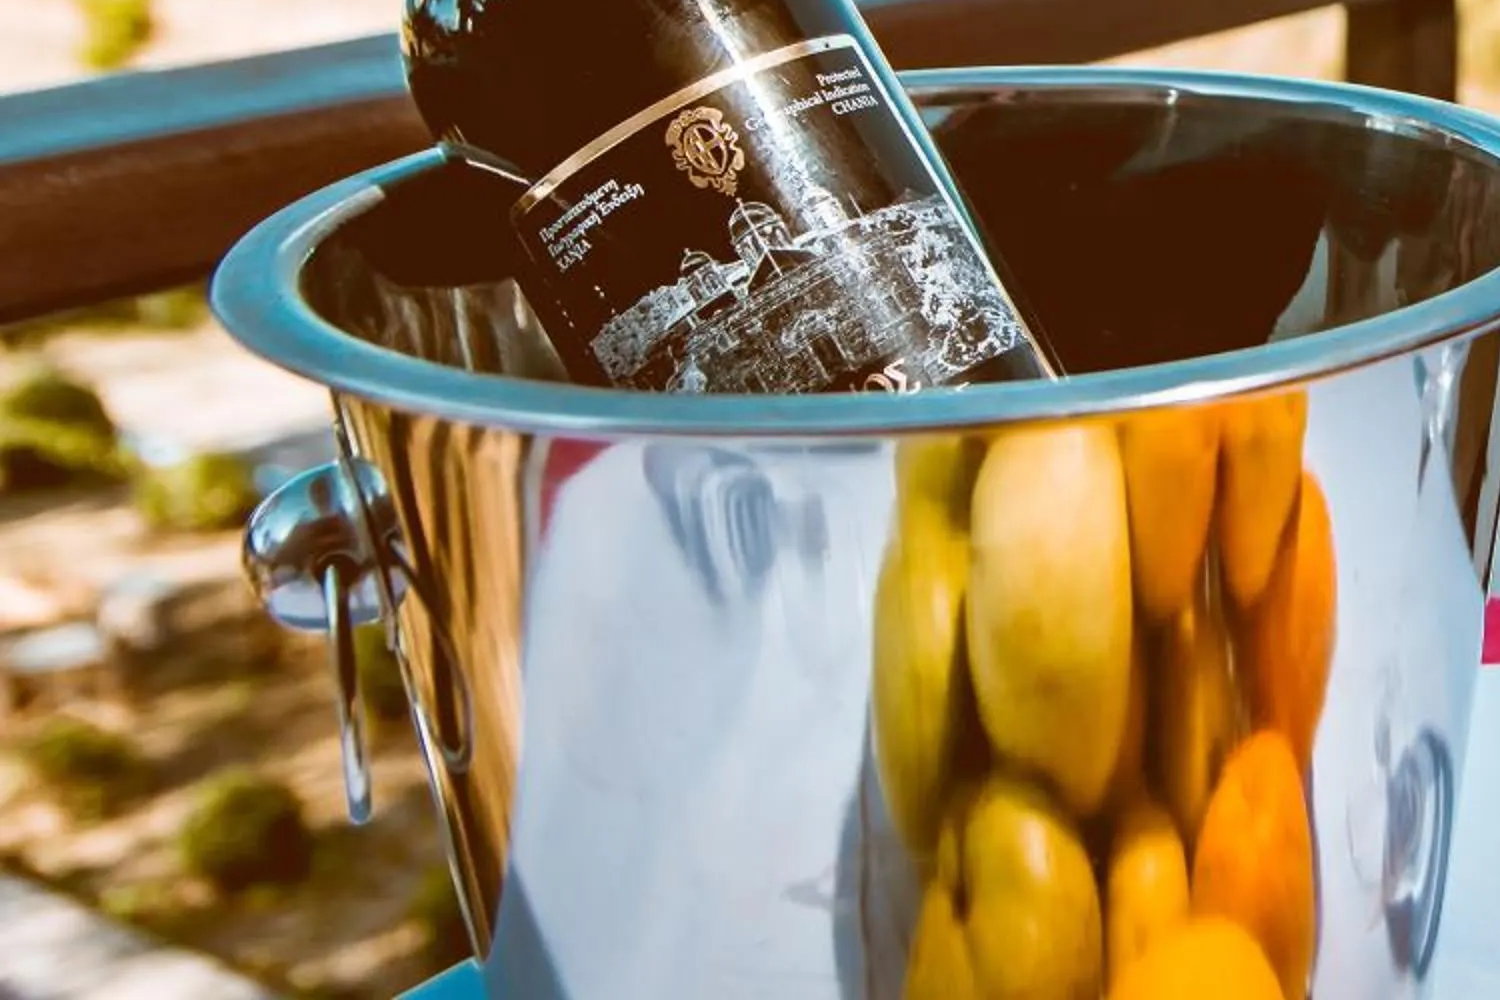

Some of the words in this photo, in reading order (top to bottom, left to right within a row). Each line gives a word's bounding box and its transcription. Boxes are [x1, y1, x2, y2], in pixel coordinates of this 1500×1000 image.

[816, 65, 862, 87] Protected
[821, 82, 870, 101] Indication
[831, 95, 879, 115] CHANIA
